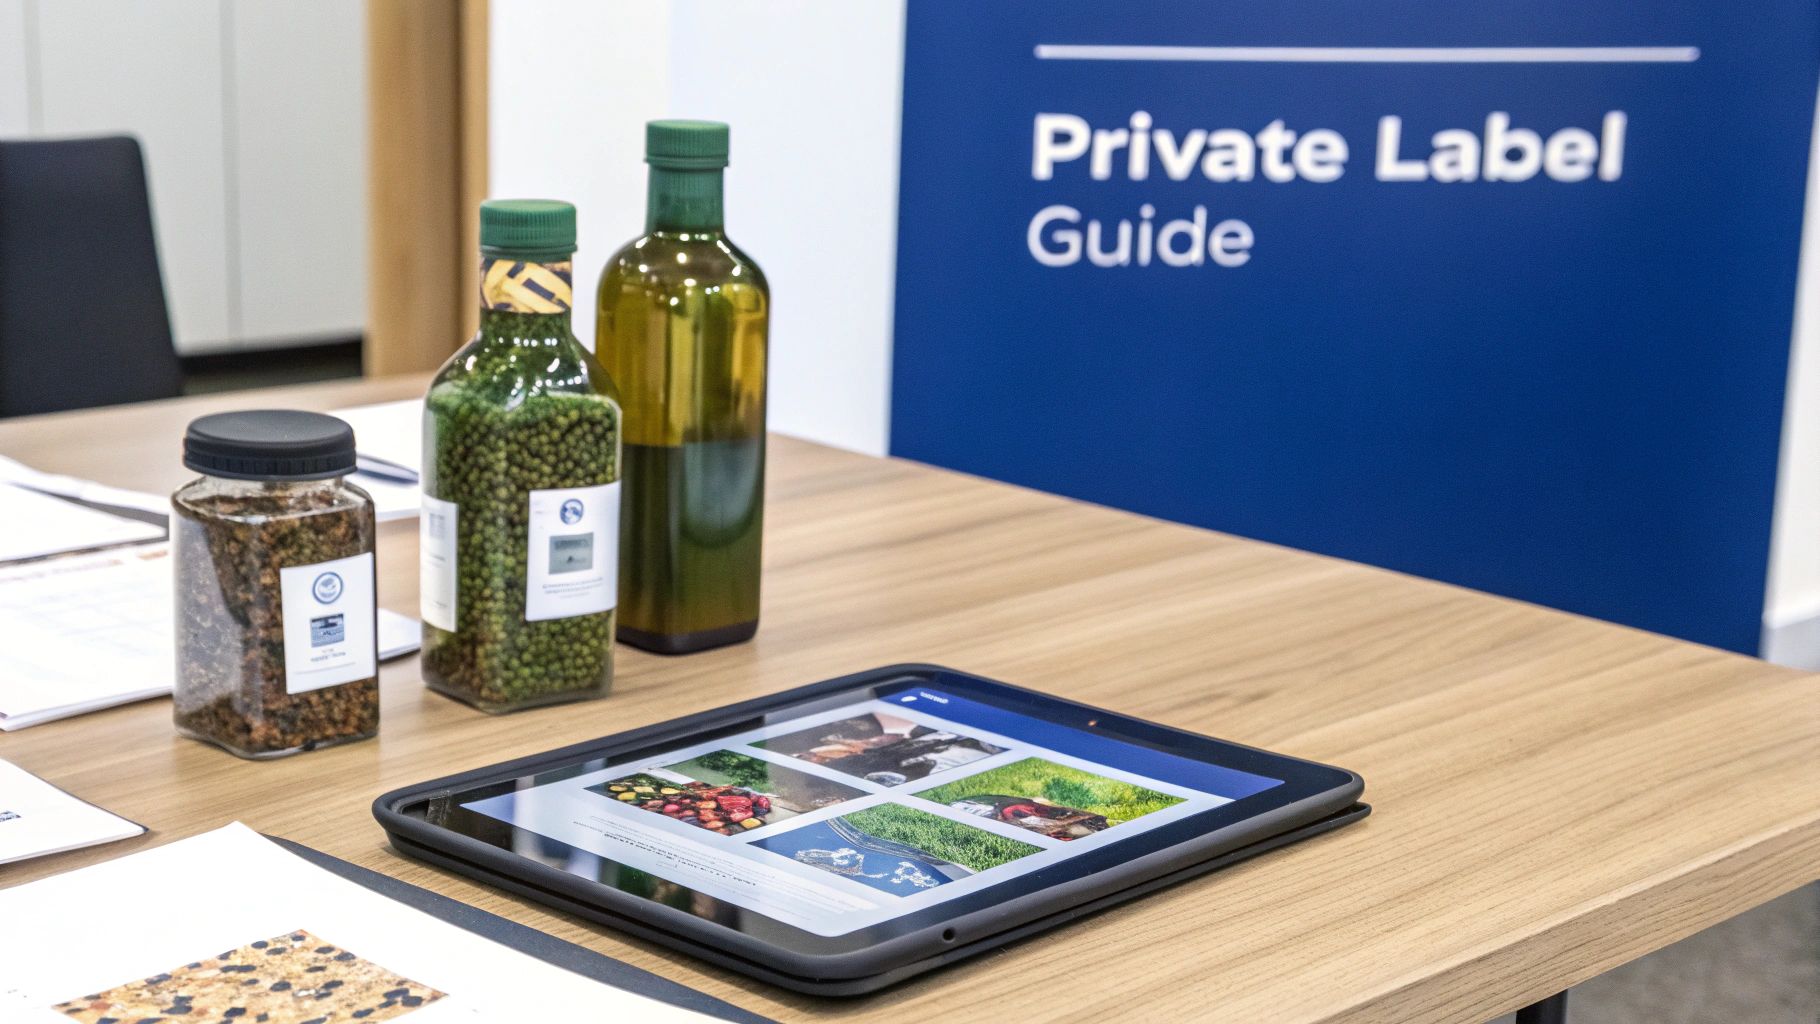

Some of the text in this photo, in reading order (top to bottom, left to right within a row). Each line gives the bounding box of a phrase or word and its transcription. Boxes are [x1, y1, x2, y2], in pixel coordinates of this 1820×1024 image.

[1032, 110, 1627, 183] Private Label
[1027, 204, 1254, 267] Guide
